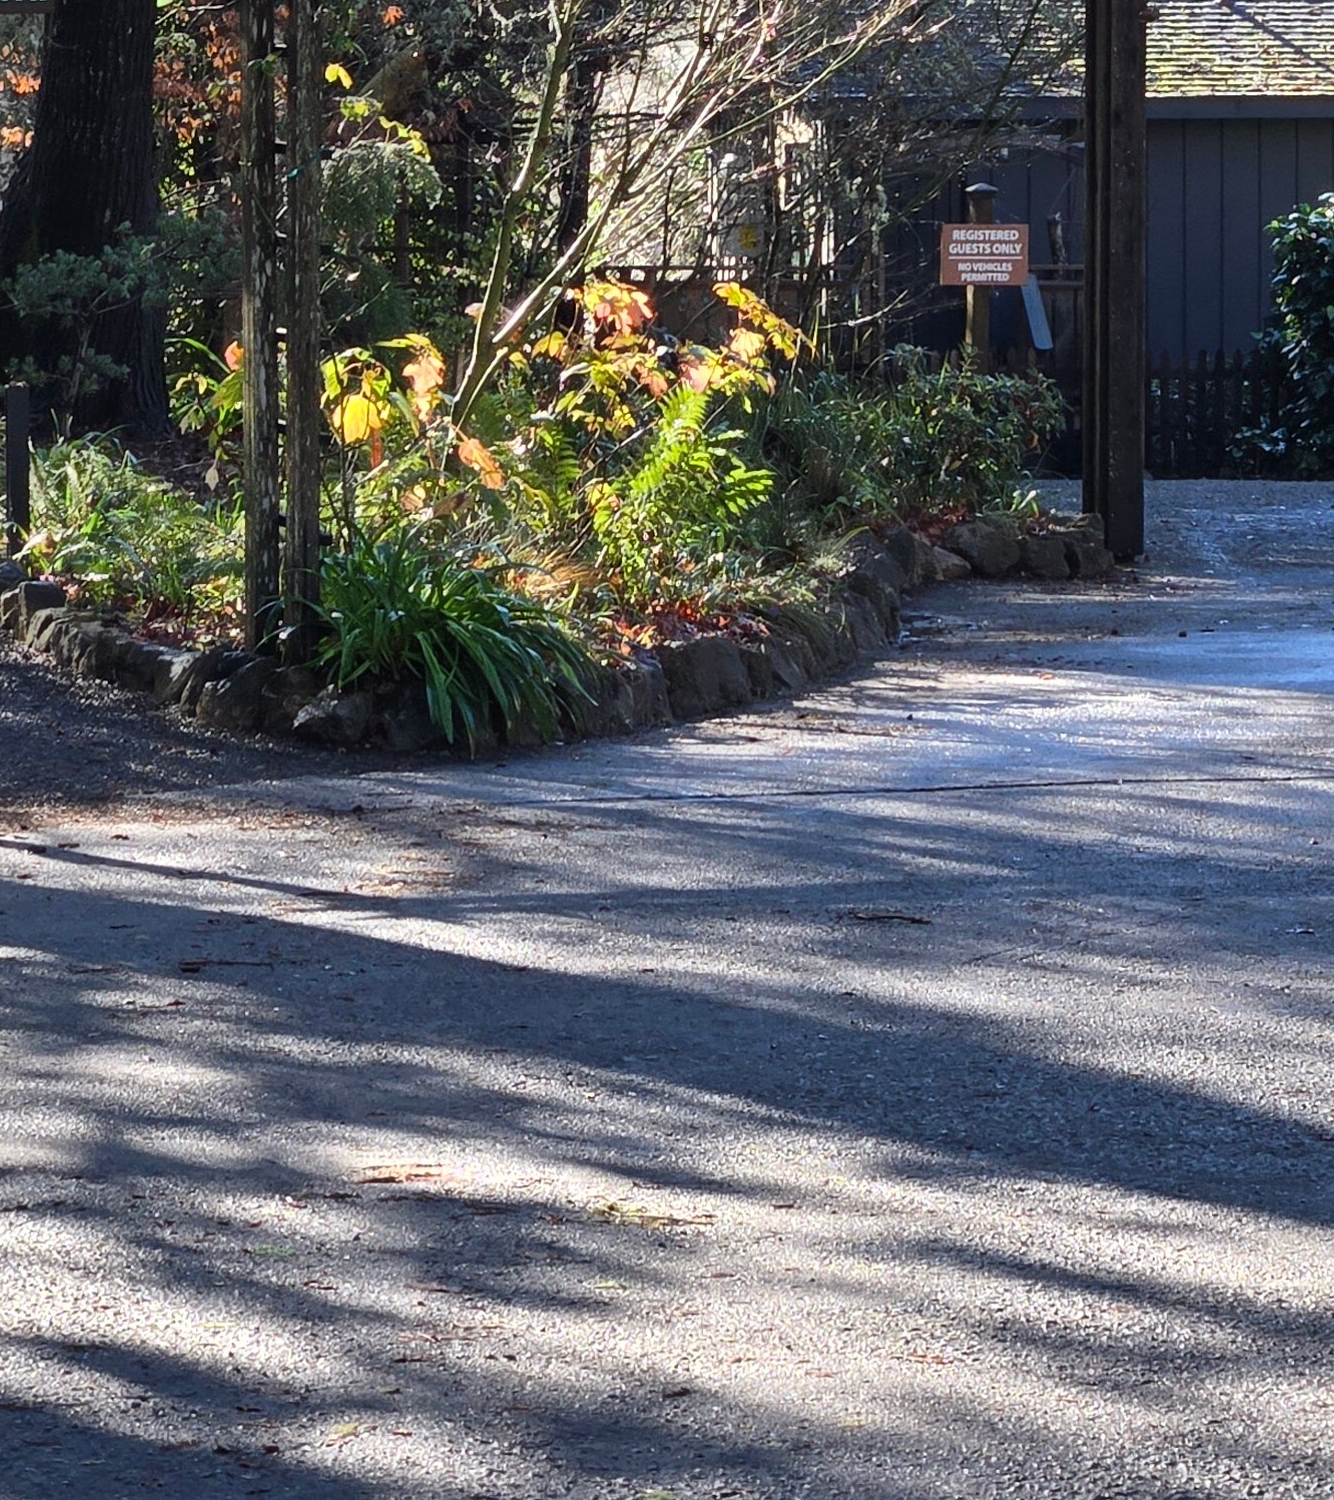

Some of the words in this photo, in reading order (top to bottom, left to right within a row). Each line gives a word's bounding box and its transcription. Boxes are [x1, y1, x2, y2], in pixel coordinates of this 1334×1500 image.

[952, 229, 1019, 241] REGISTERED
[948, 243, 991, 254] GUESTS
[992, 243, 1023, 254] ONLY
[958, 262, 972, 271] NO
[972, 262, 1013, 271] VEHICLES
[961, 272, 1010, 282] PERMITTED
